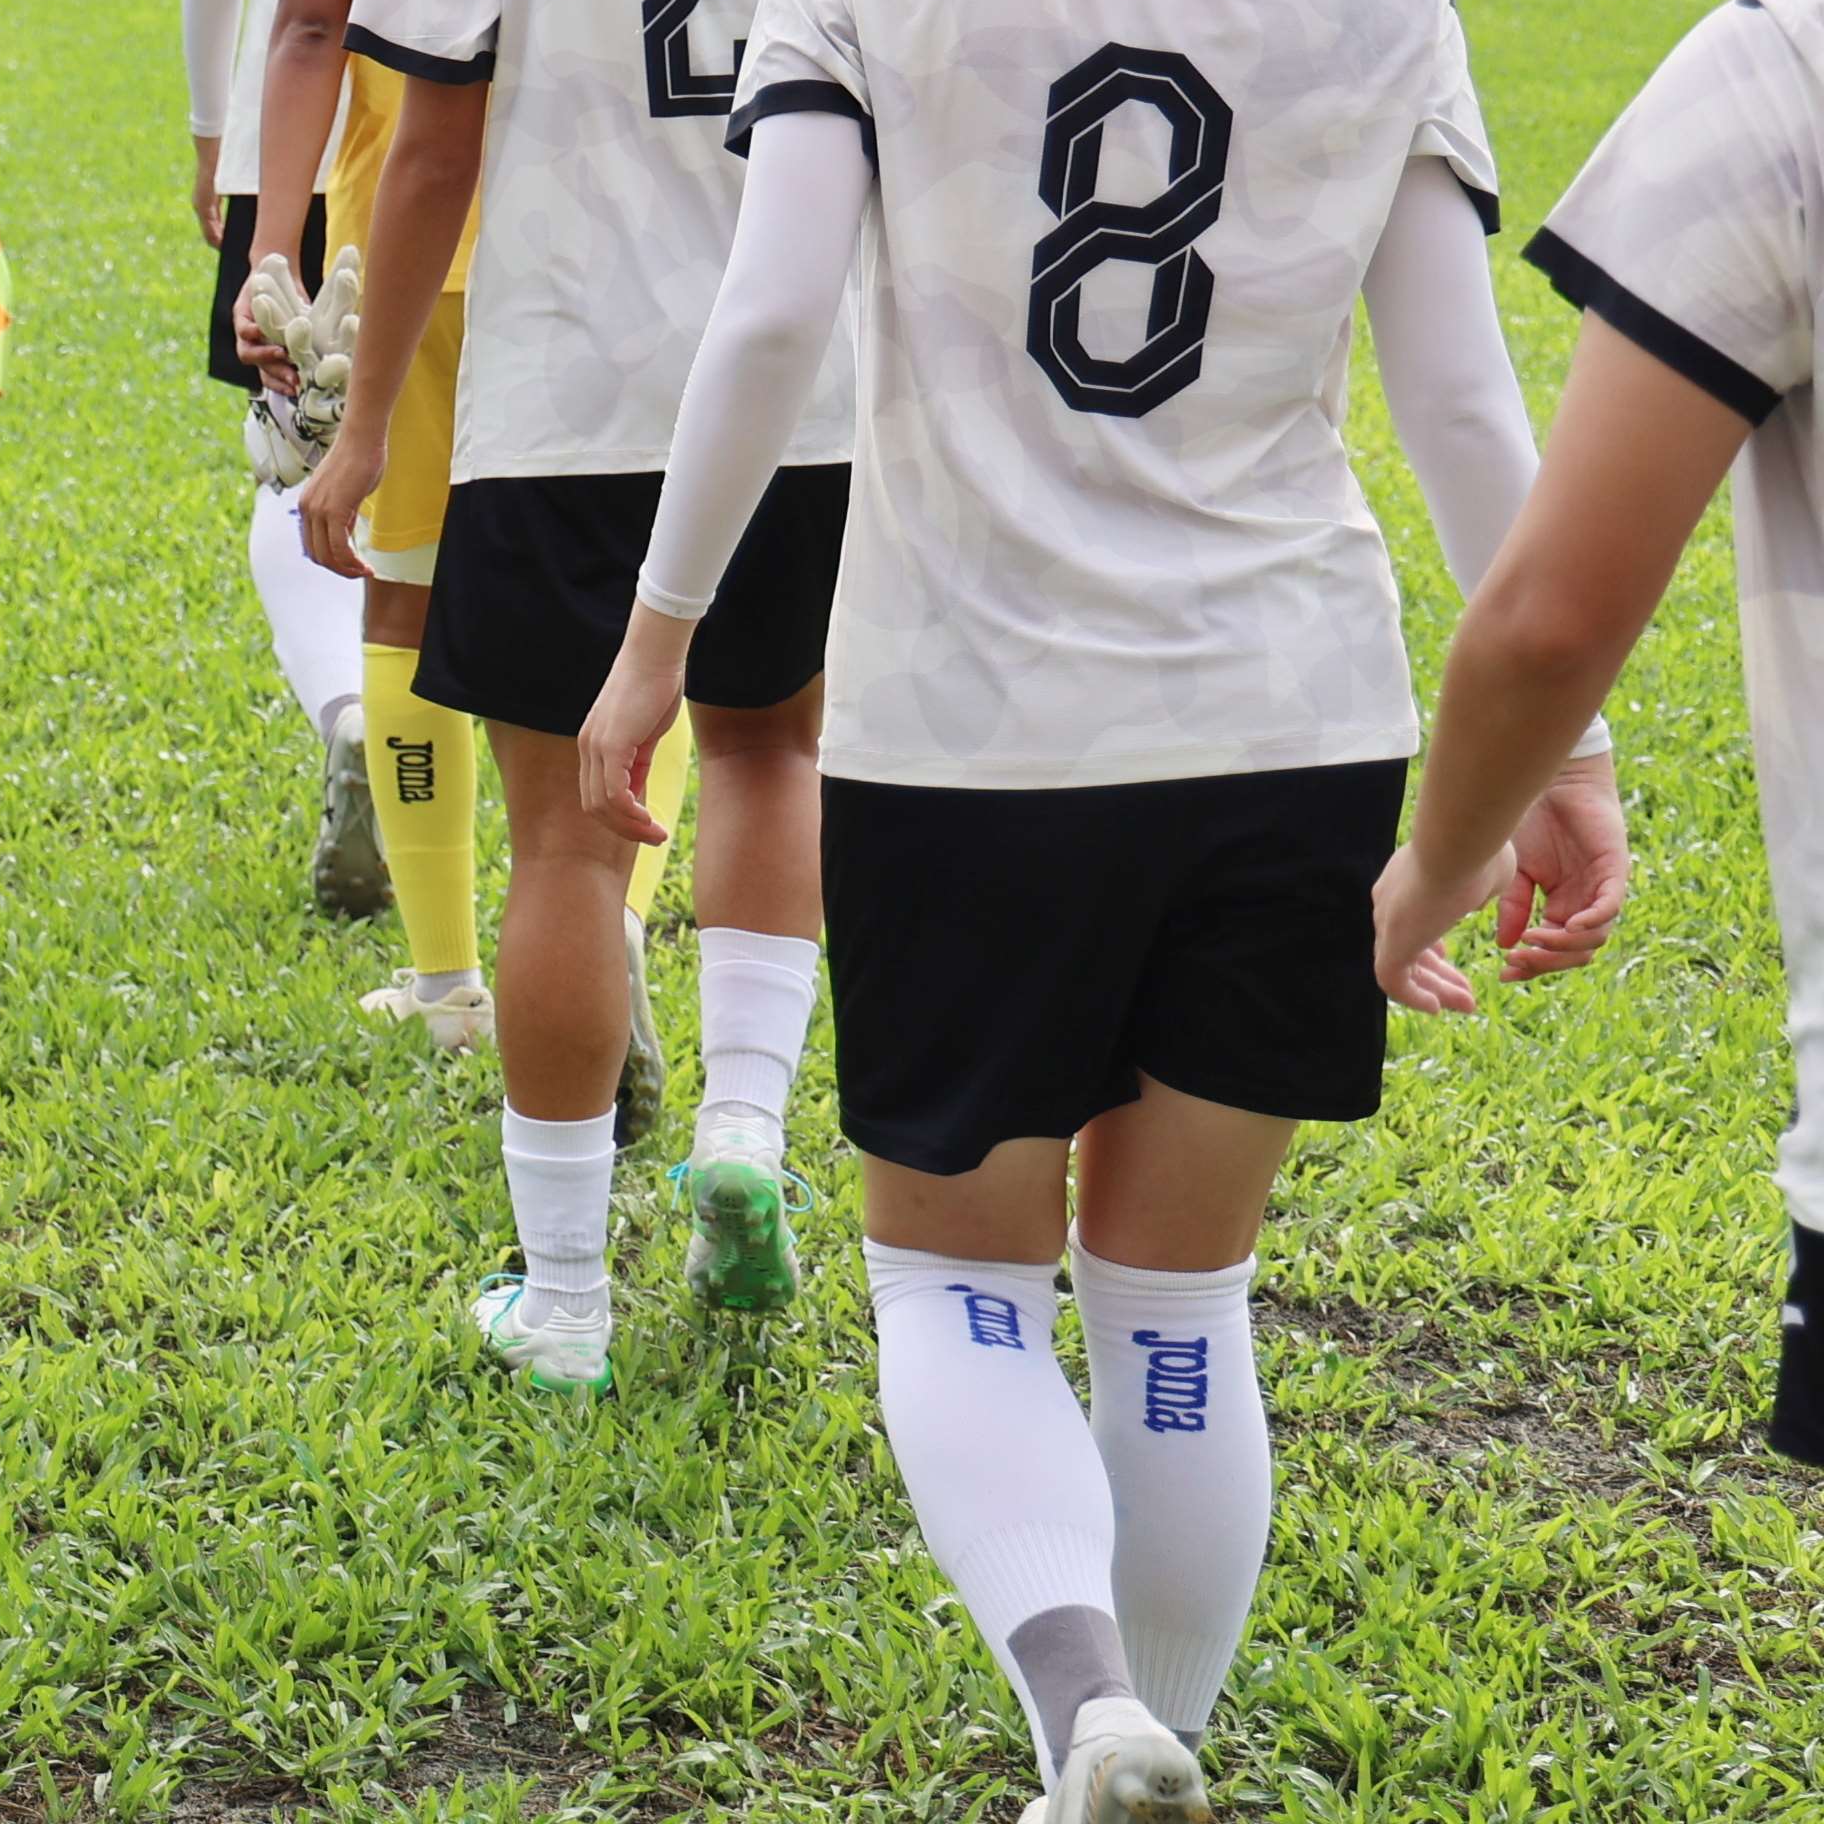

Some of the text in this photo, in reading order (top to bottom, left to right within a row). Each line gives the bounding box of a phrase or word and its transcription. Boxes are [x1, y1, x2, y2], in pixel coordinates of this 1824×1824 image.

[1026, 42, 1233, 419] 8
[386, 736, 435, 804] Joma
[1132, 1329, 1209, 1434] Joma
